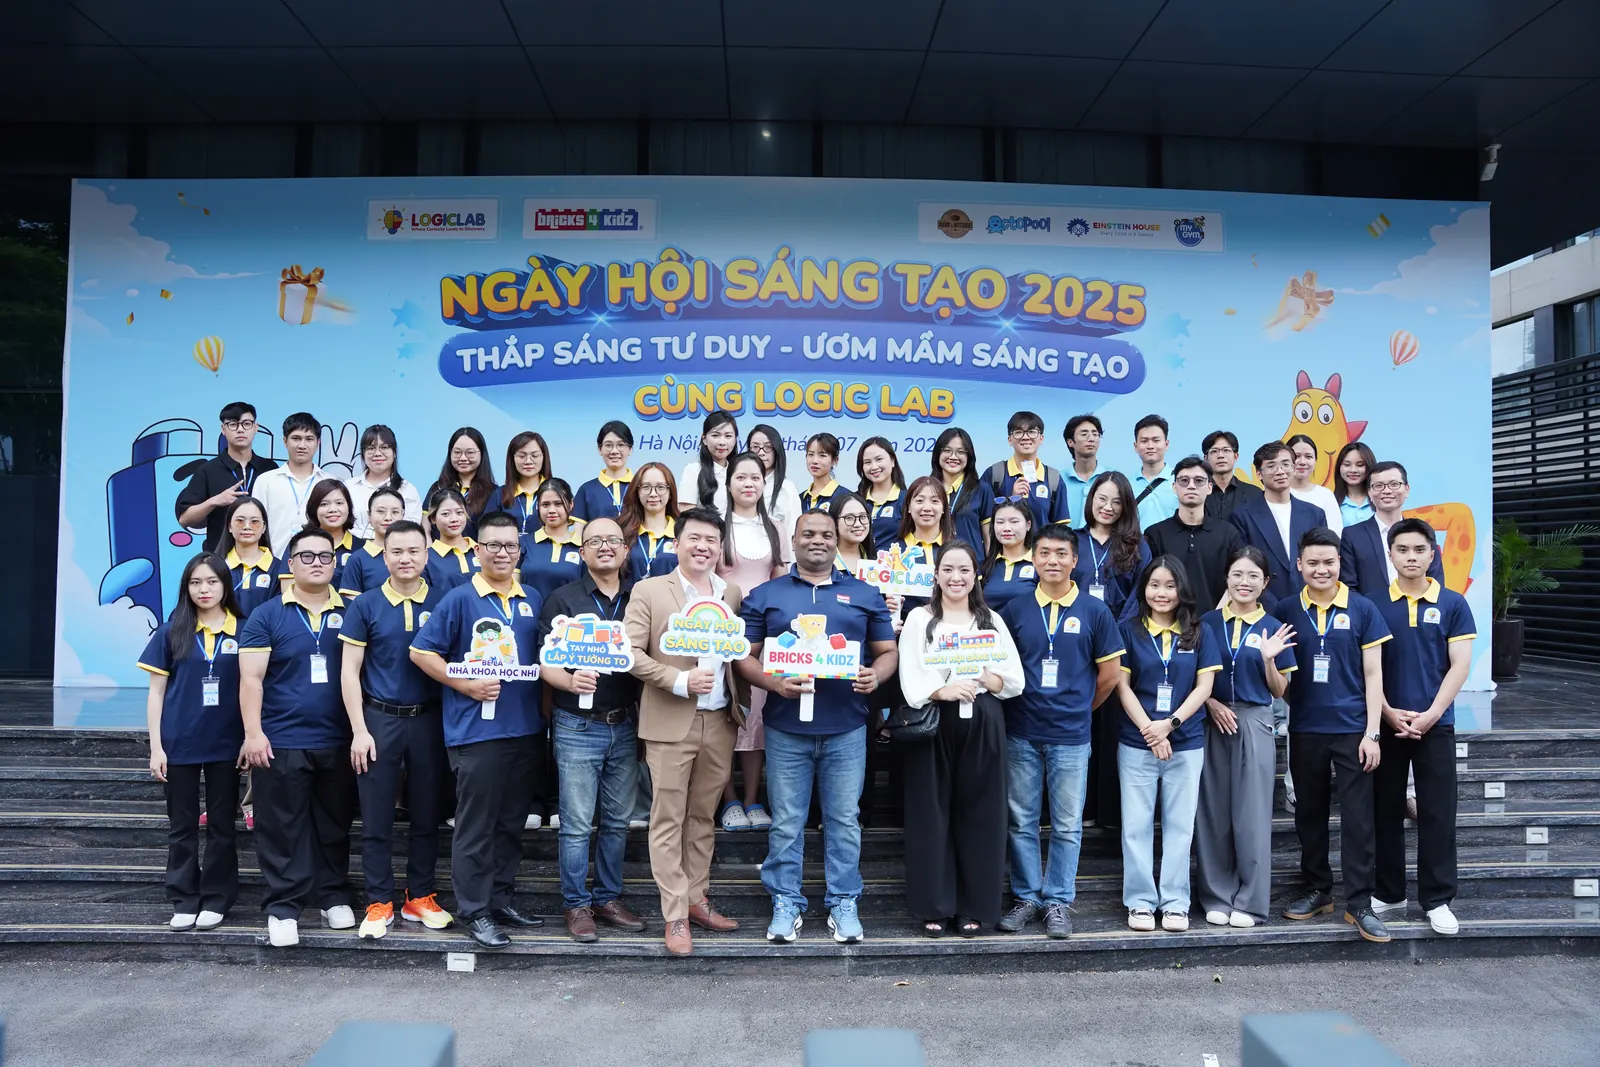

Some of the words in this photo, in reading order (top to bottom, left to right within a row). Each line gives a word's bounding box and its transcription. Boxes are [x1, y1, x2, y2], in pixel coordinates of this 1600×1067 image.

[588, 214, 598, 226] 4
[1093, 222, 1131, 231] EINSTEIN
[1132, 223, 1160, 232] HOUSE
[440, 254, 593, 319] NGÀY
[607, 247, 707, 314] HỘI
[724, 246, 879, 302] SÁNG
[895, 263, 1007, 319] TẠO
[1023, 273, 1147, 326] 2025
[456, 334, 544, 373] THẮP
[553, 333, 642, 365] SÁNG
[650, 332, 697, 361] TƯ
[704, 333, 772, 360] DUY
[802, 331, 877, 361] ƯƠM
[886, 330, 963, 366] MẦM
[972, 337, 1059, 374] SÁNG
[1067, 350, 1130, 384] TẠO
[633, 374, 743, 416] CÙNG
[754, 381, 869, 414] LOGIC
[880, 384, 955, 418] LAB
[639, 435, 663, 451] Hà
[904, 437, 937, 453] 202
[673, 616, 712, 632] NGÀY
[714, 619, 741, 637] HỘI
[570, 644, 586, 653] TAY
[665, 634, 710, 653] SÁNG
[712, 639, 746, 658] TẠO
[613, 658, 627, 666] TO
[769, 652, 813, 664] BRICKS
[815, 653, 824, 665] 4
[826, 653, 854, 666] KIDZ
[449, 665, 469, 675] NHÀ
[471, 667, 497, 676] KHOA
[499, 668, 519, 678] HỌC
[521, 667, 538, 678] NHÍ
[955, 665, 980, 675] 2025
